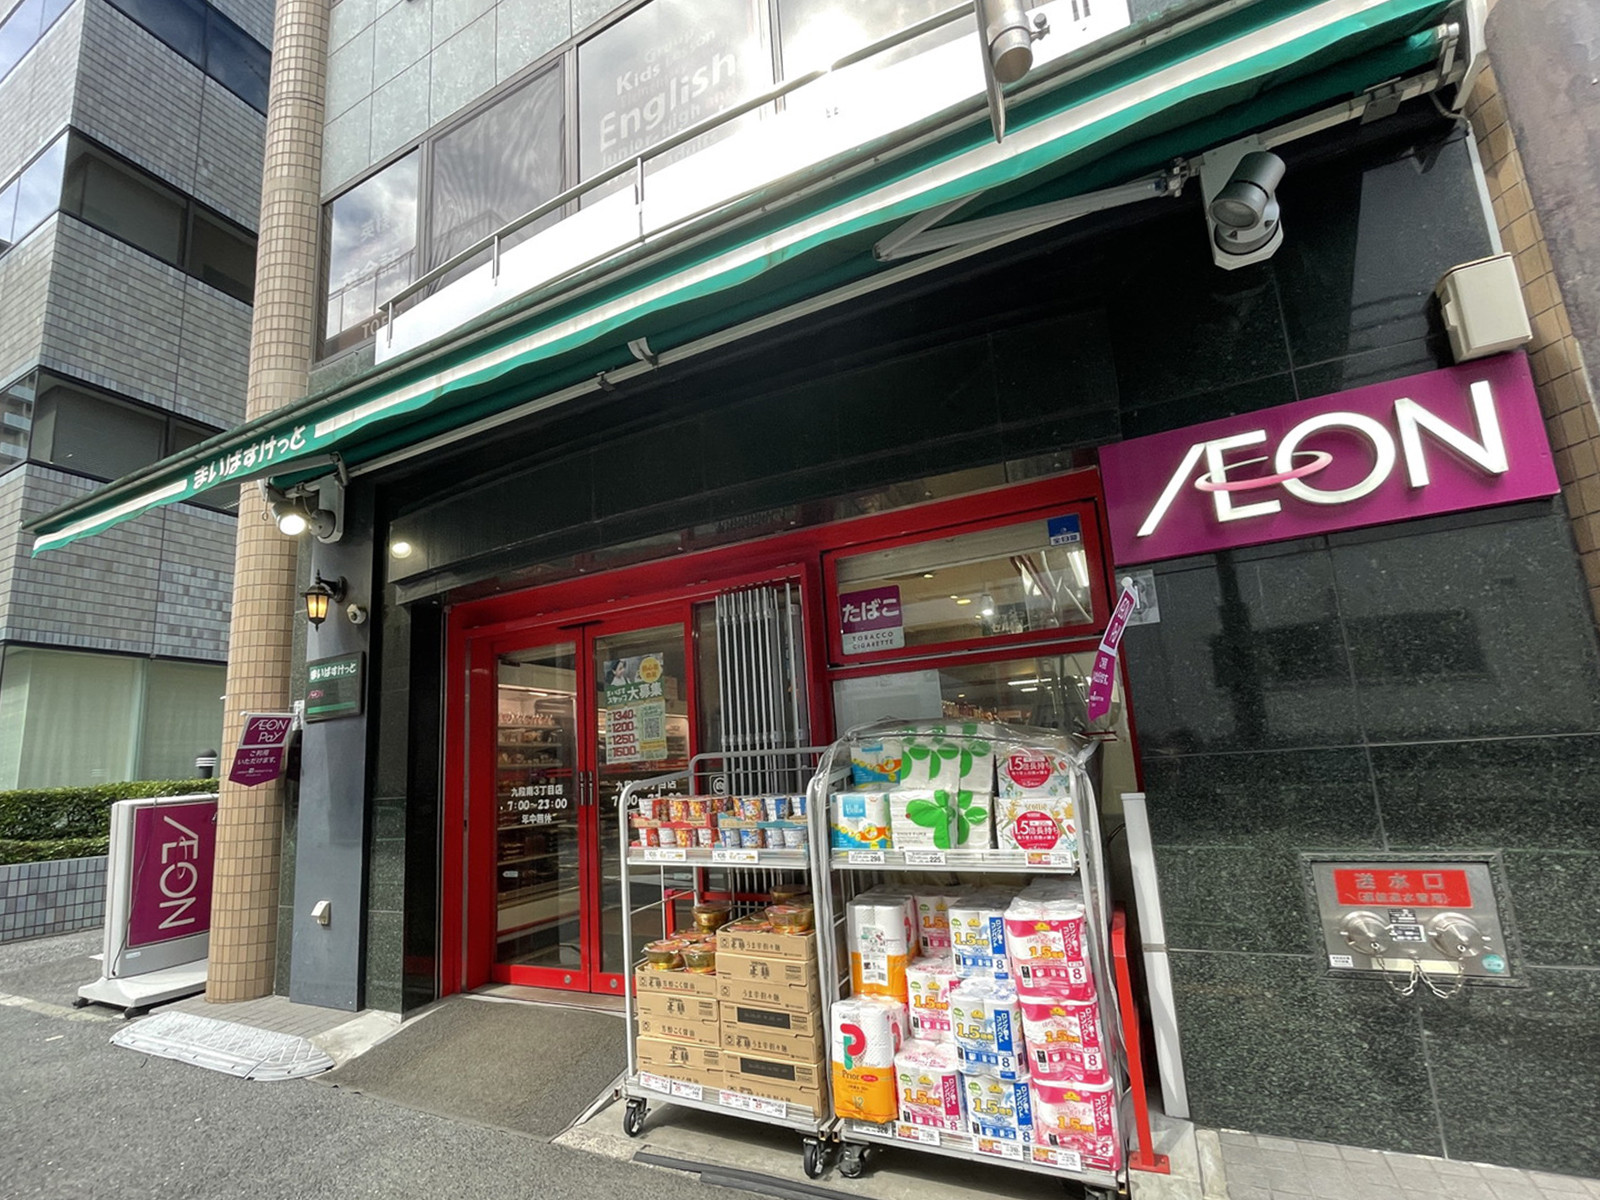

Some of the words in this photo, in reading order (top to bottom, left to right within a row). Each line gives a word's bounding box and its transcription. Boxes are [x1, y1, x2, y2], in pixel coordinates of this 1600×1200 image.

[616, 64, 661, 96] Kids
[600, 53, 737, 151] English
[193, 425, 306, 489] まいばすけっと
[842, 598, 900, 624] たばこ
[852, 631, 894, 642] TOBACCO
[853, 639, 894, 650] CIGARETTE
[612, 721, 634, 733] 1200
[996, 960, 1004, 970] 8
[1073, 968, 1082, 979] 8
[1002, 1058, 1010, 1068] 8
[1088, 1055, 1098, 1066] 8
[950, 1121, 958, 1131] 8
[1022, 1132, 1031, 1142] 8
